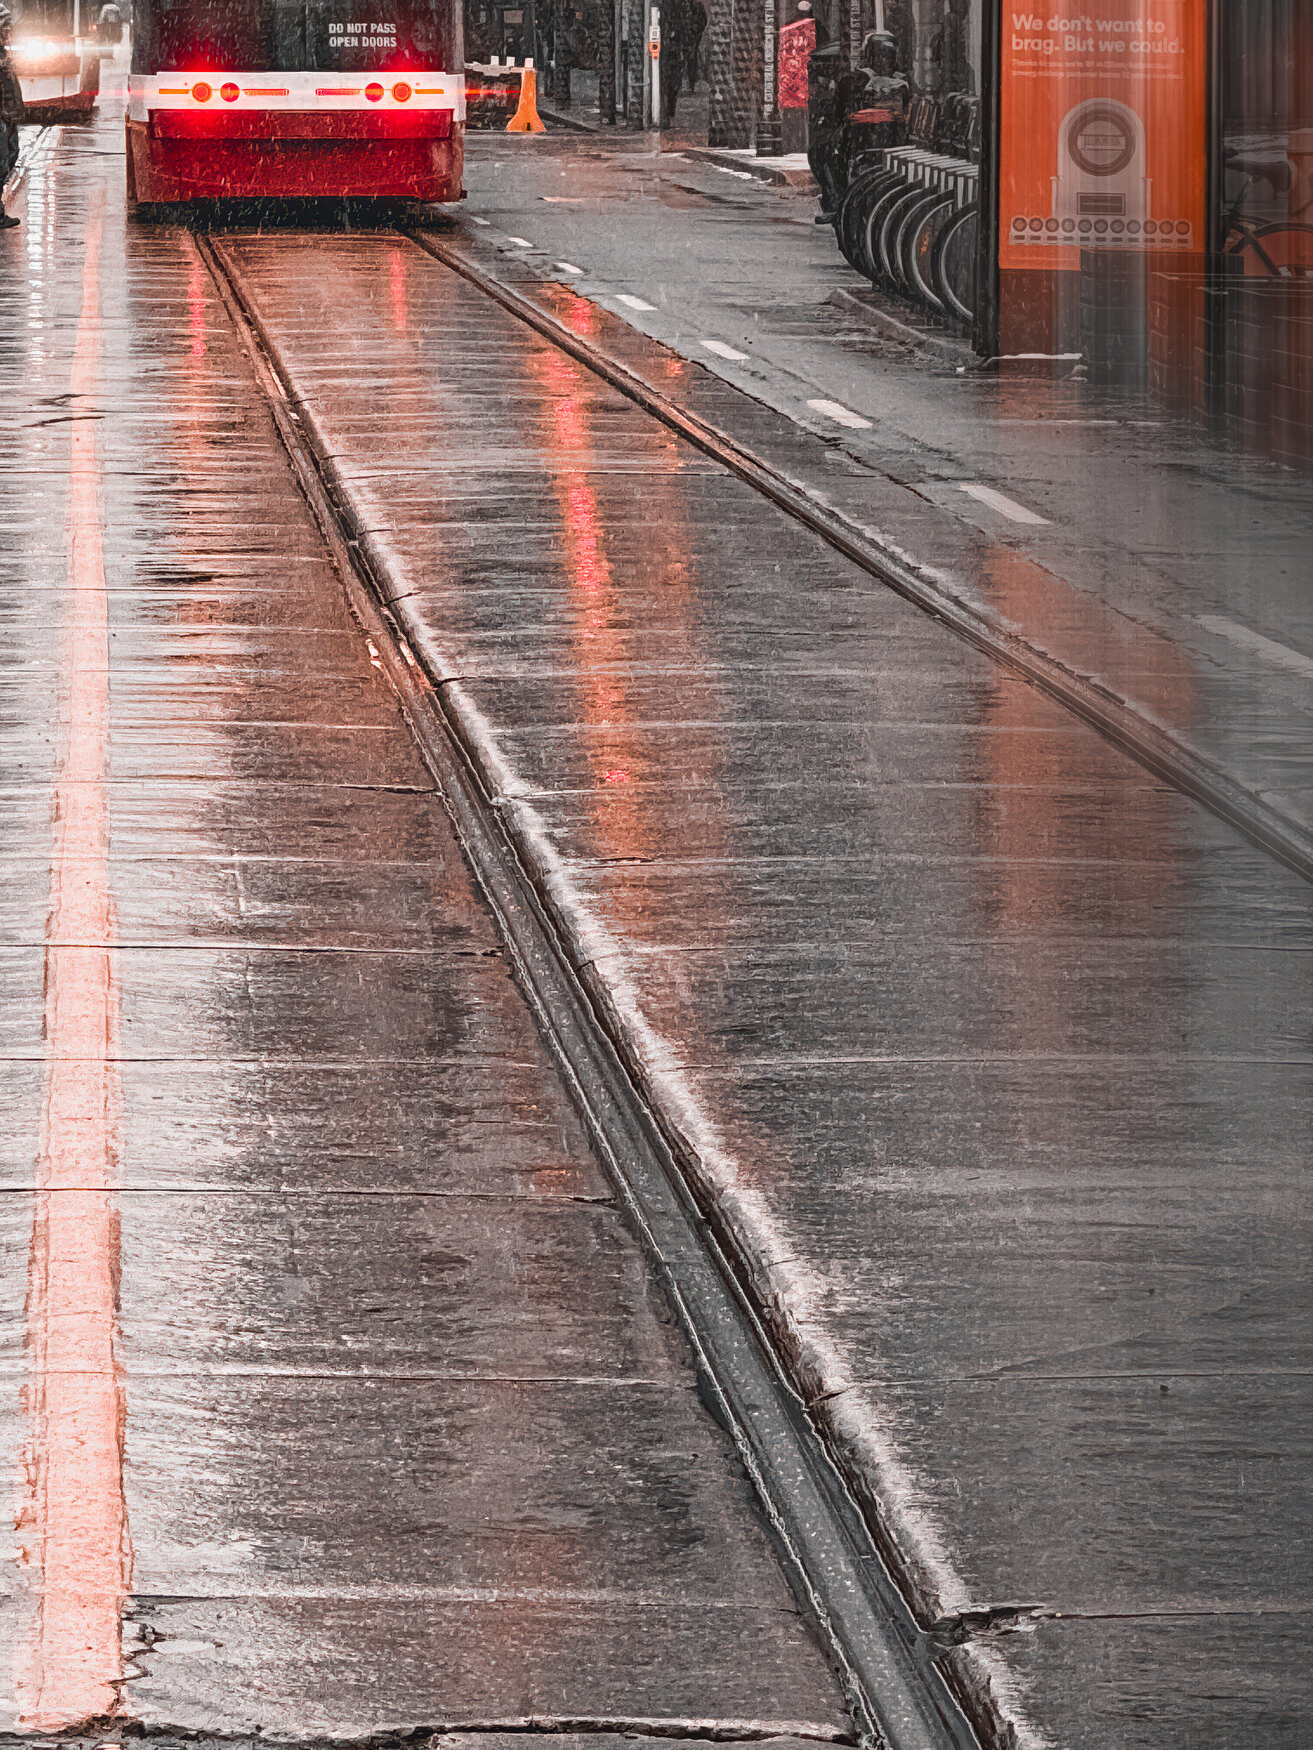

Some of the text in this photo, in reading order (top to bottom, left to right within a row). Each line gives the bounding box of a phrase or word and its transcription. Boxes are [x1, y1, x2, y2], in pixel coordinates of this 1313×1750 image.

[328, 23, 397, 34] DO NOT PASS
[1011, 13, 1166, 33] We don't want to
[329, 36, 397, 47] OPEN DOORS
[1011, 34, 1185, 55] brag. But we could.
